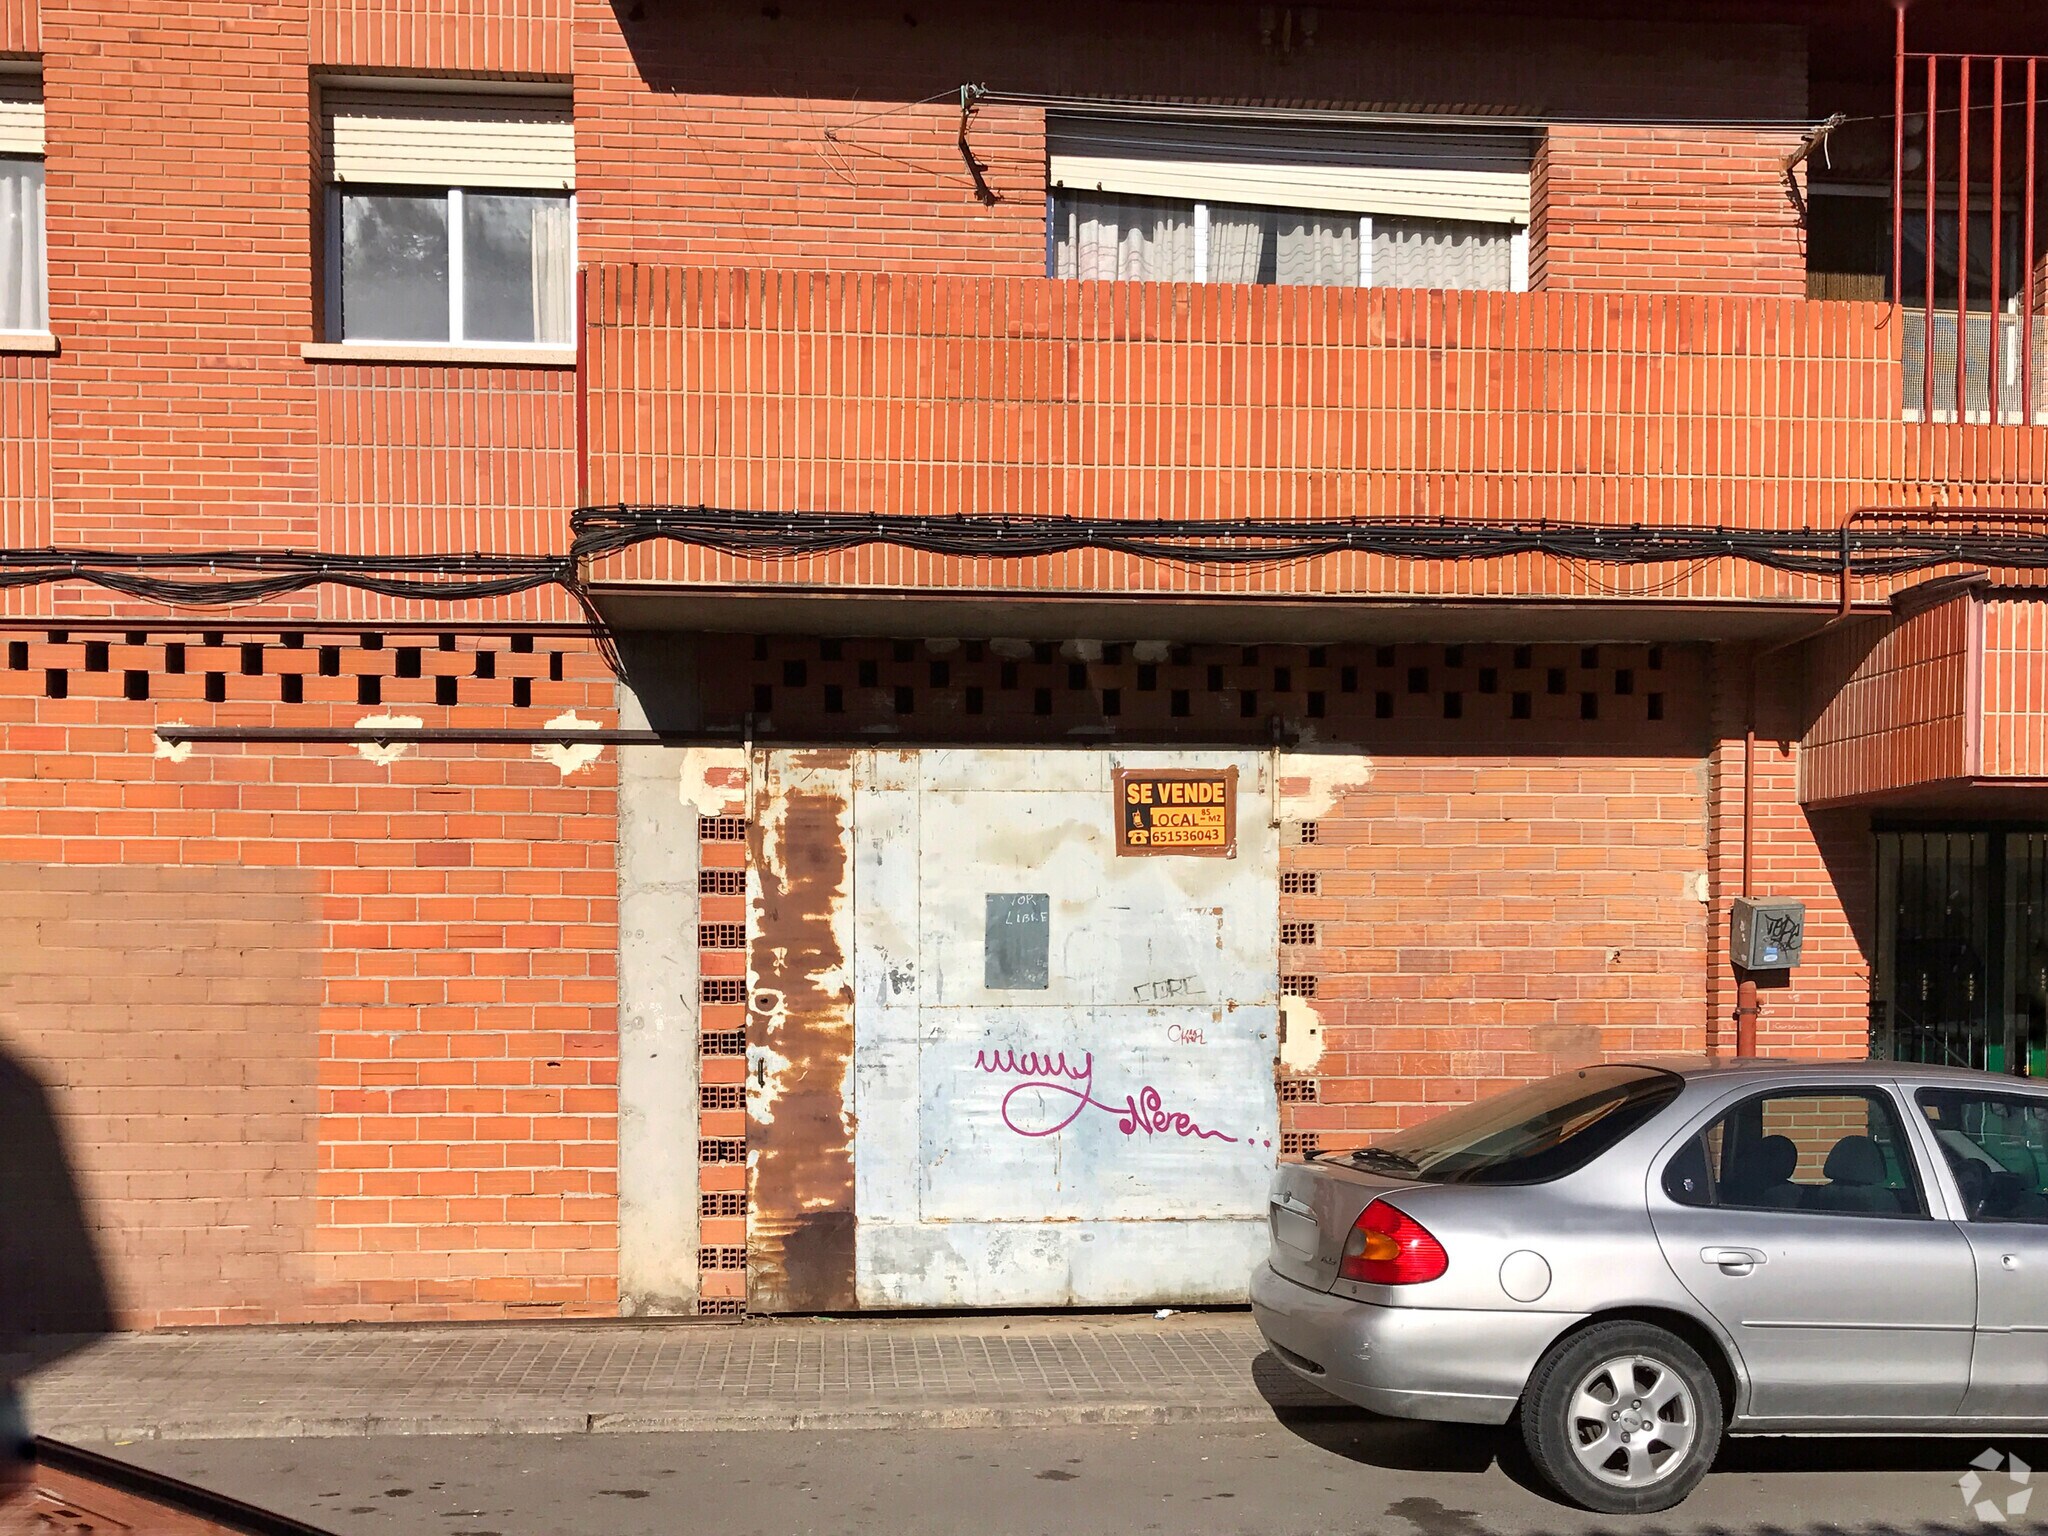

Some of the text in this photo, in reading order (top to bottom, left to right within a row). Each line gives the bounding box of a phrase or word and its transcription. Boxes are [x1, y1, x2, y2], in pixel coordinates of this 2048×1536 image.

[1127, 782, 1225, 804] SE VENDE
[1151, 813, 1199, 827] LOCAL
[1152, 829, 1219, 842] 651536043
